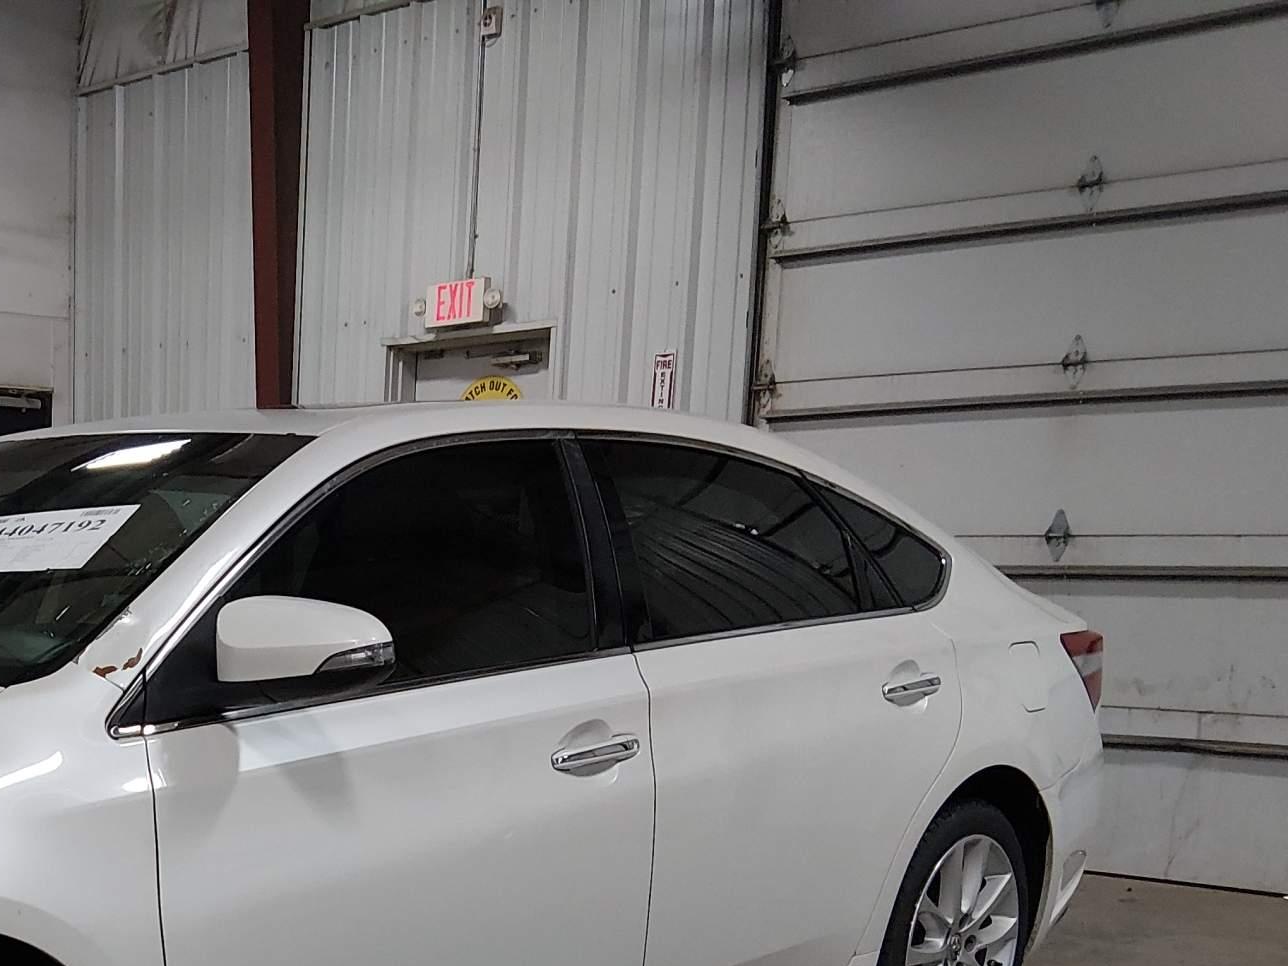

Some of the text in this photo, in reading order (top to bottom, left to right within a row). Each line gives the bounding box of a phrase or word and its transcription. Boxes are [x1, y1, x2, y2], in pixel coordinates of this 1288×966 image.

[436, 281, 474, 321] EXIT
[656, 360, 672, 370] FIRE
[489, 380, 508, 393] OUT
